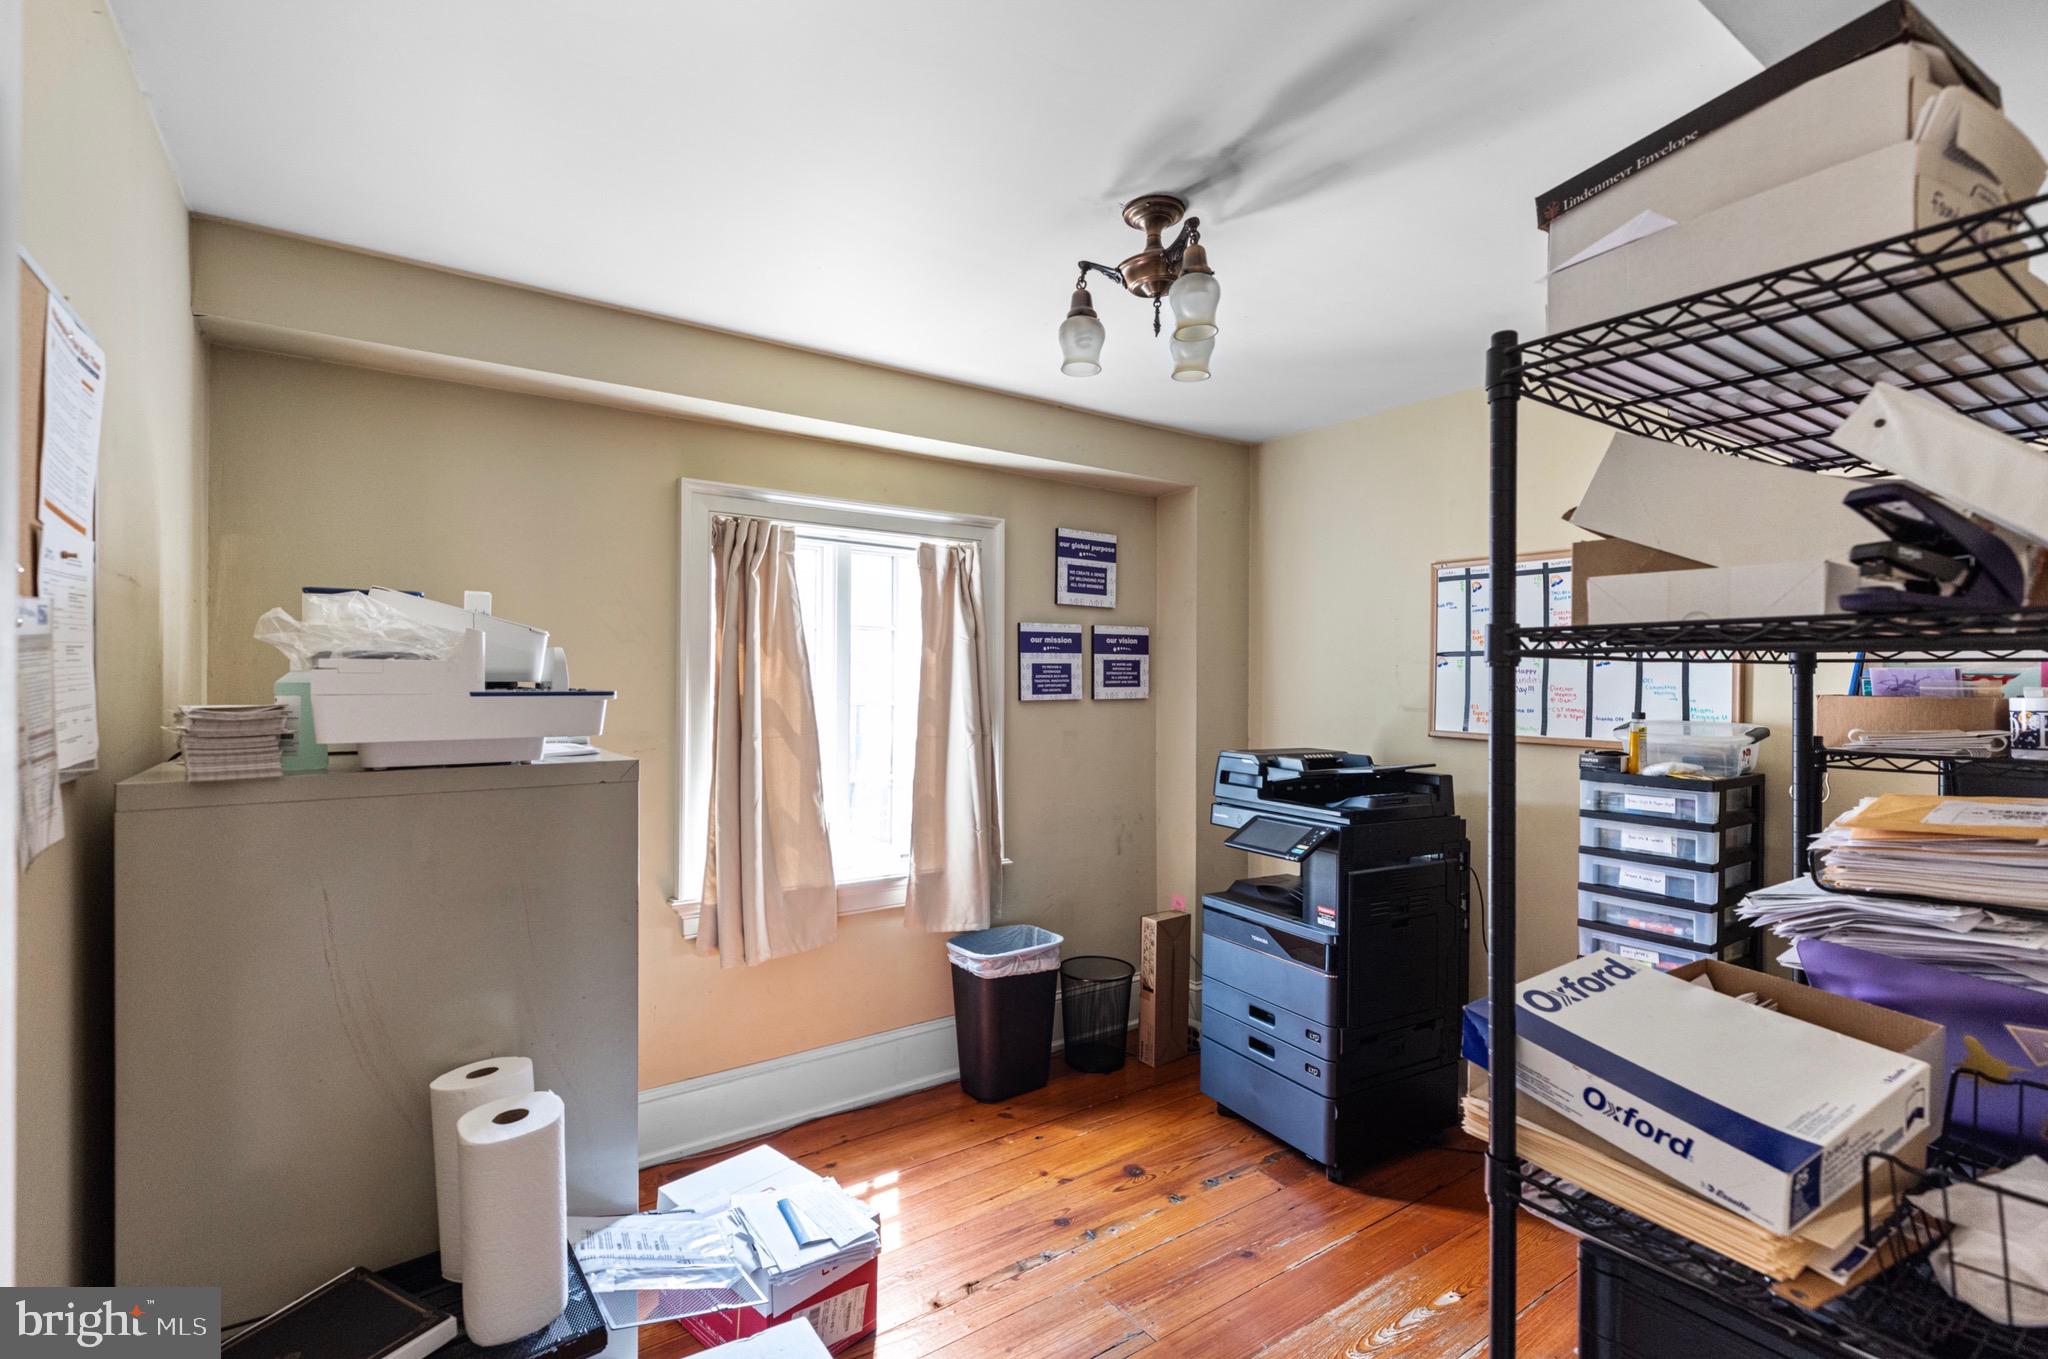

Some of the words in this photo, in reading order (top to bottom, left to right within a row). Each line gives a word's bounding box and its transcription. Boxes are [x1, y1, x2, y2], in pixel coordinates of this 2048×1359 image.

[1563, 166, 1633, 211] Lindenmeyr
[1637, 130, 1699, 170] Envelope
[1071, 542, 1090, 550] global
[1091, 545, 1115, 553] purpose
[1044, 636, 1072, 644] mission
[1251, 934, 1269, 944] TOSHIBA
[1522, 957, 1637, 1013] Oxford
[1583, 1086, 1695, 1160] Oxford
